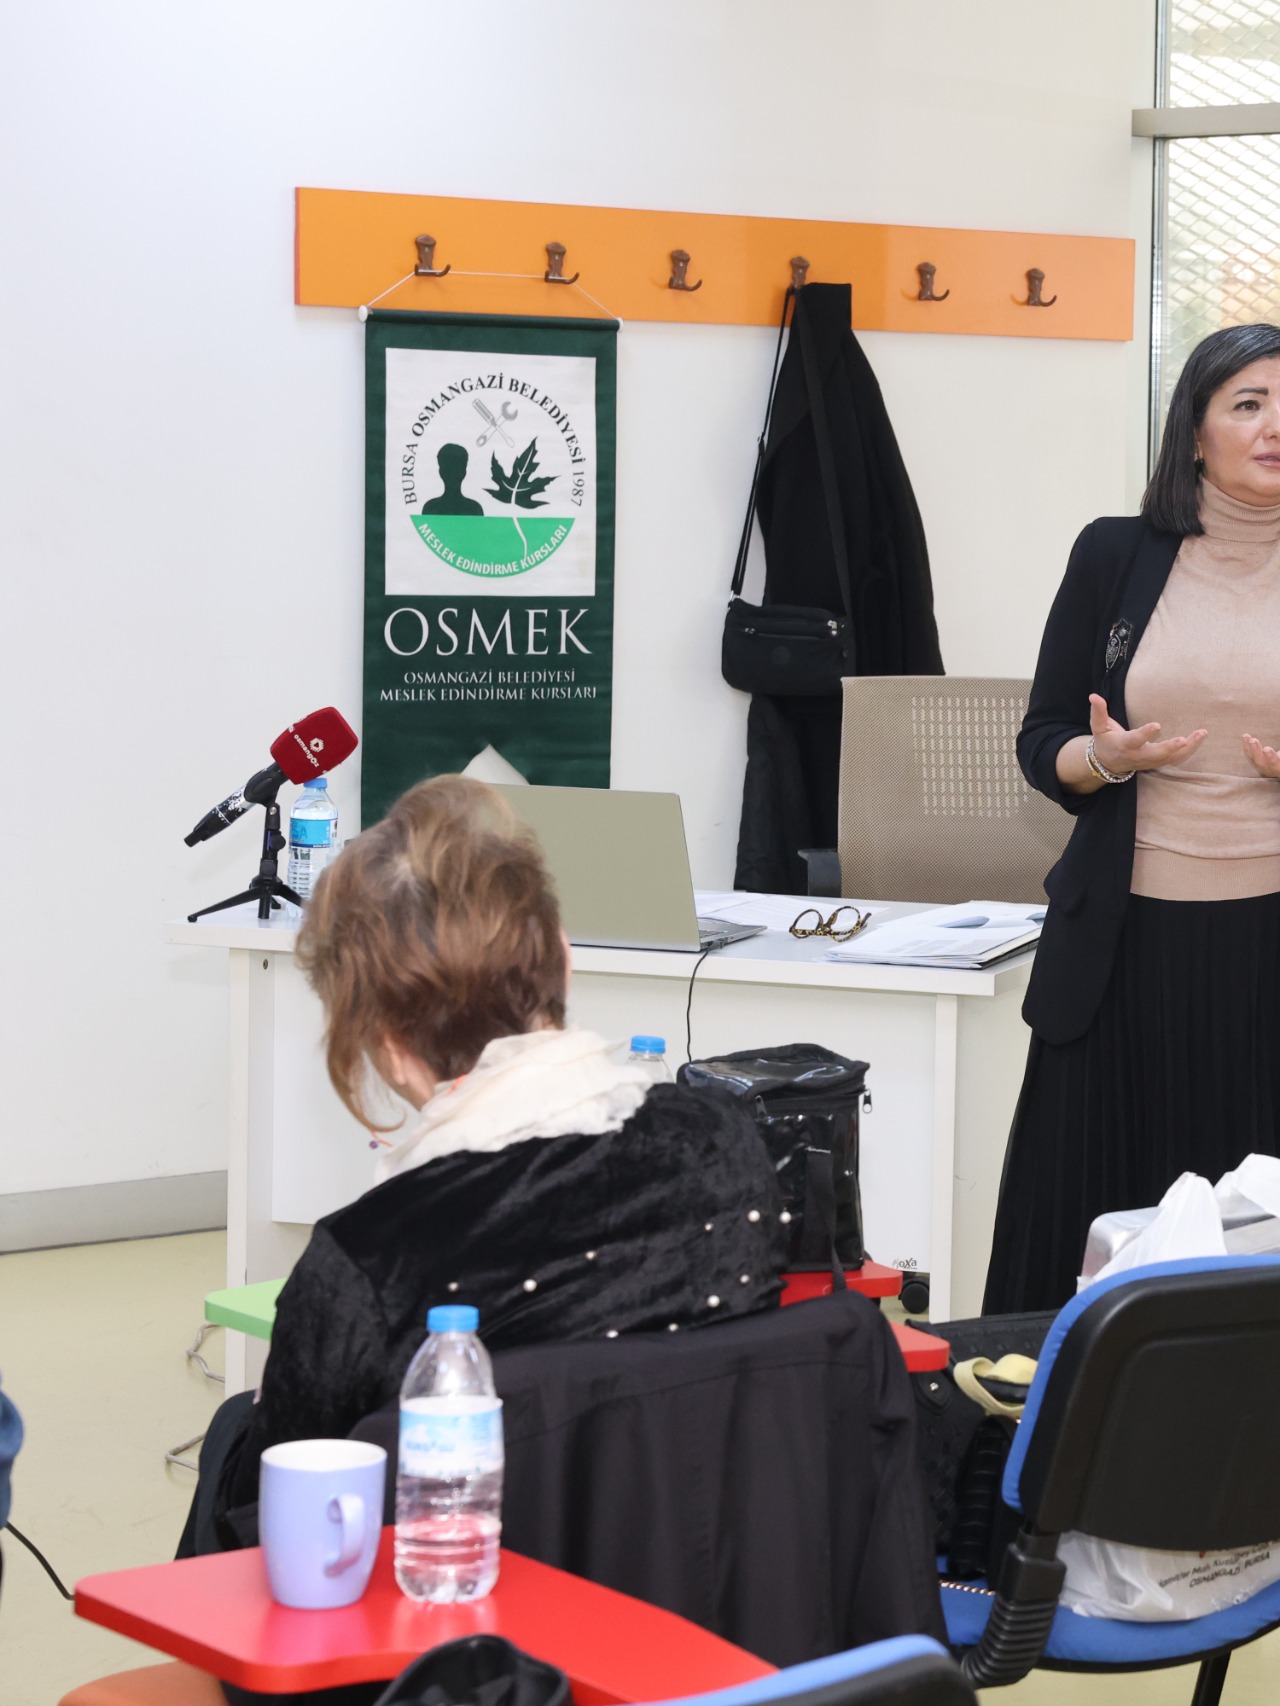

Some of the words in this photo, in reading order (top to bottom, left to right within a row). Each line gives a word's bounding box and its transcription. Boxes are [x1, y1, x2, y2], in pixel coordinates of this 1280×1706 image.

[401, 442, 419, 505] BURSA
[411, 372, 504, 438] OSMANGAZİ
[508, 376, 587, 465] BELEDİYESİ
[571, 470, 585, 507] 1987
[418, 522, 456, 564] MESLEK
[455, 555, 521, 576] EDİNDİRME
[519, 524, 568, 570] KURSLARI
[384, 607, 593, 656] OSMEK
[380, 688, 437, 702] MESLEK
[440, 686, 527, 702] EDİNDİRME
[531, 686, 597, 700] KURSLARI
[403, 668, 493, 685] OSMANGAZİ
[498, 667, 576, 684] BELEDİYESİ
